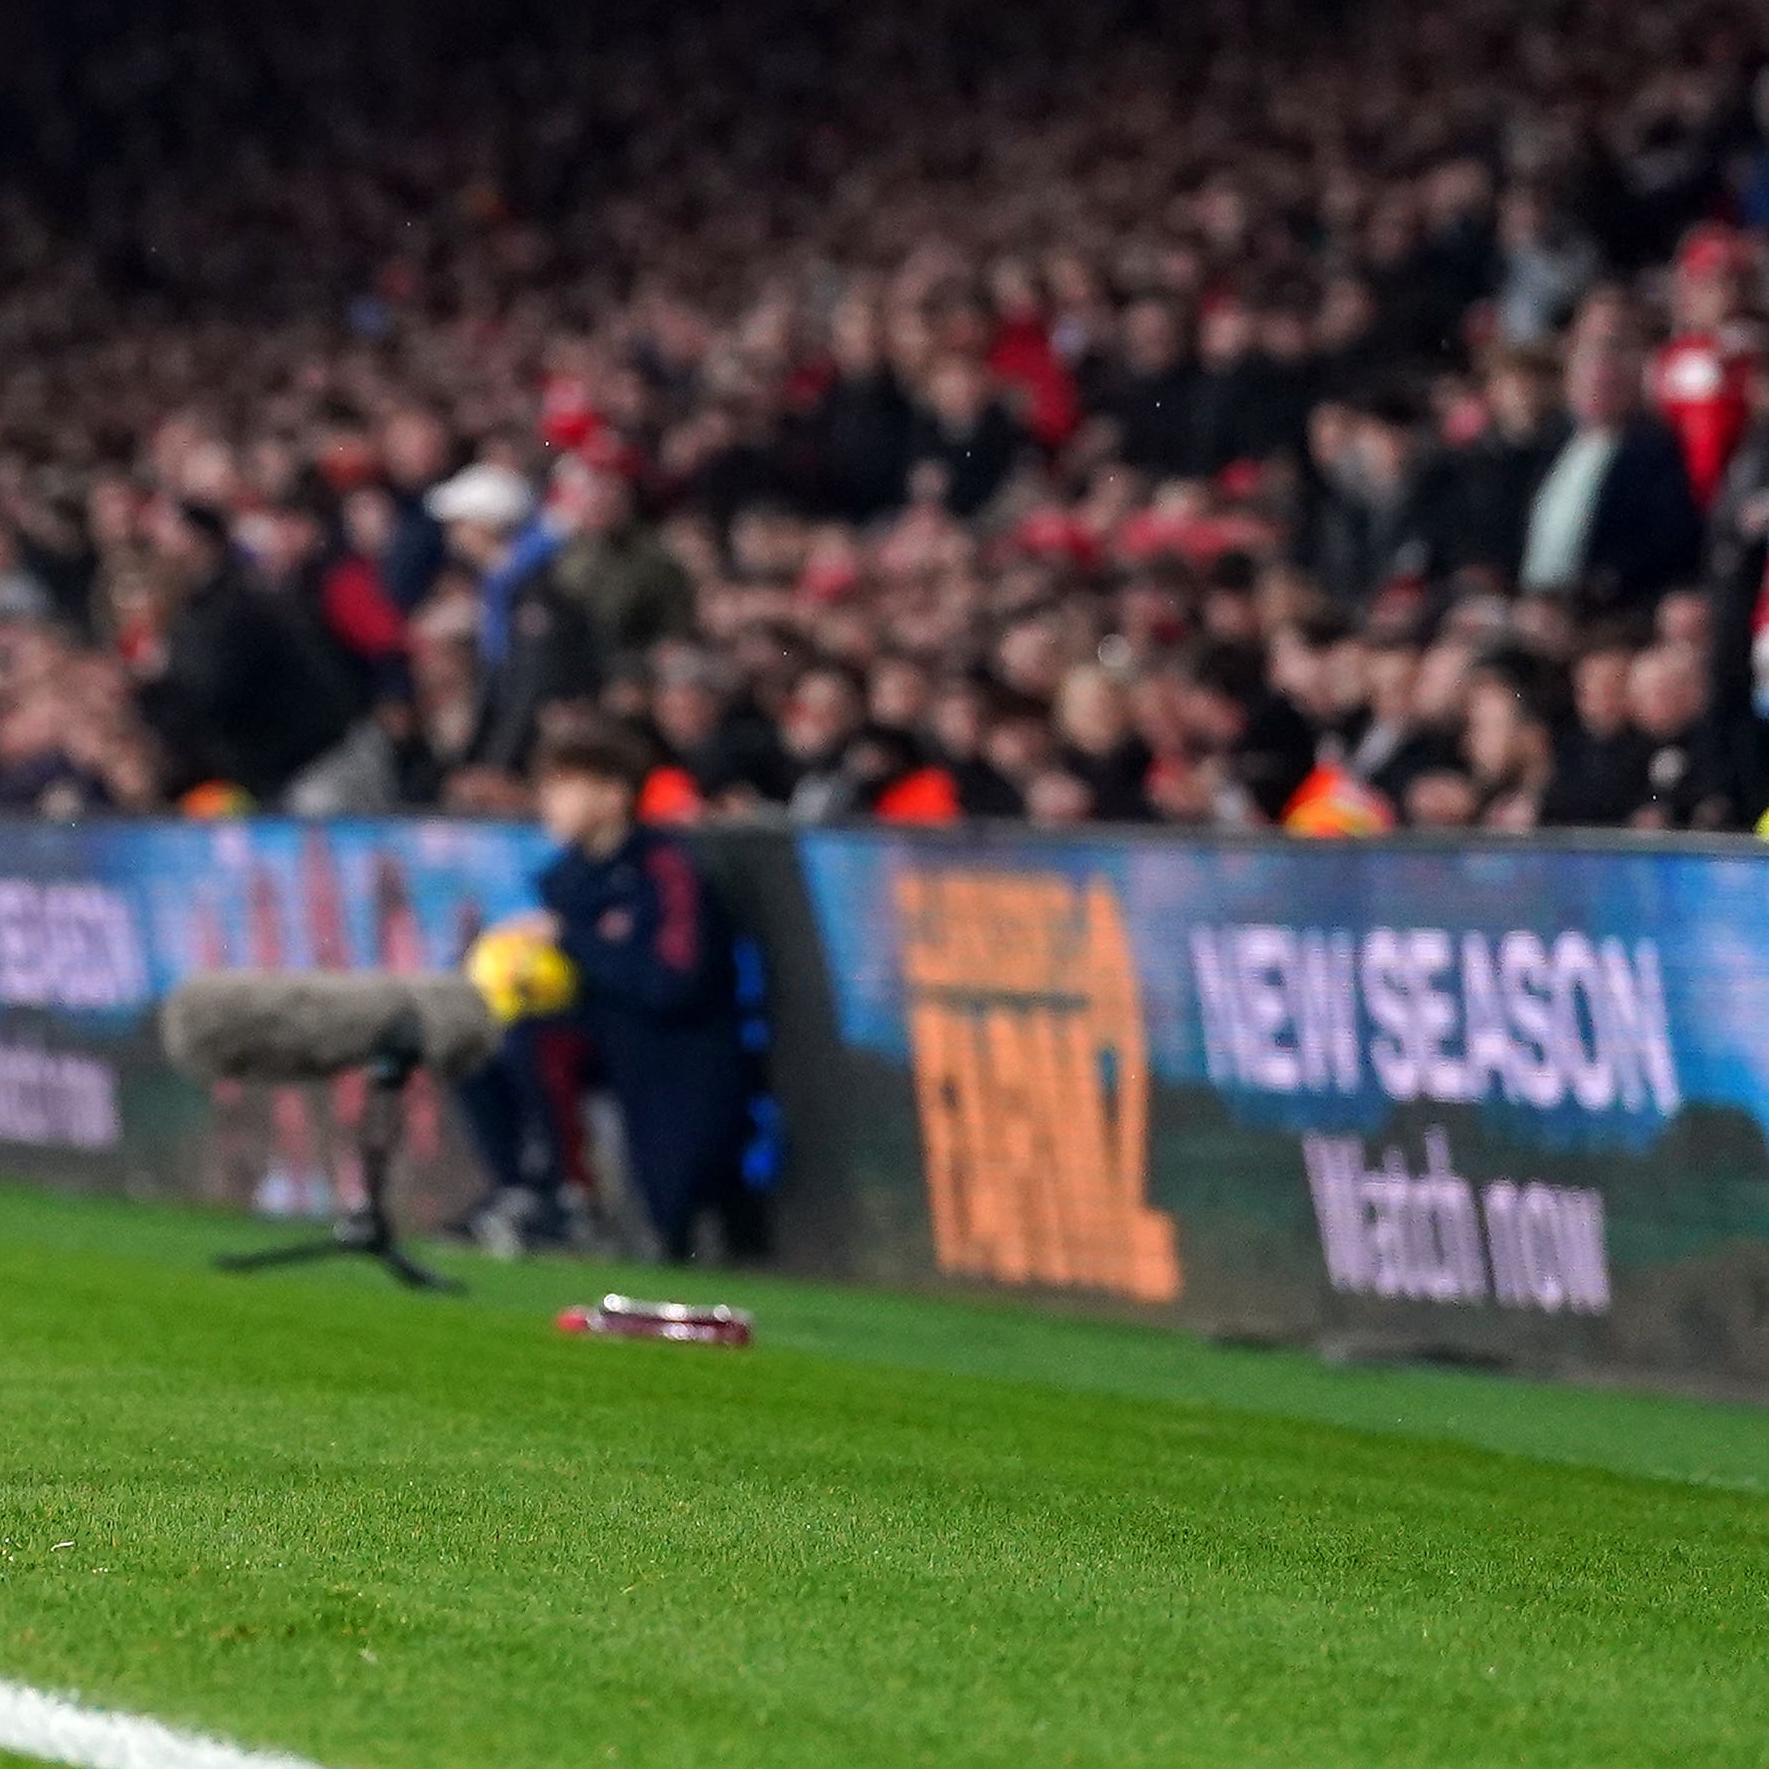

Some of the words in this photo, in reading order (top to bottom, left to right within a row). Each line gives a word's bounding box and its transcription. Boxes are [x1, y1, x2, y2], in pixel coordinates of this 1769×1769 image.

[1187, 923, 1359, 1096] NEW
[1362, 925, 1681, 1119] SEASON
[1301, 1123, 1496, 1308] Watch
[1481, 1176, 1612, 1318] now
